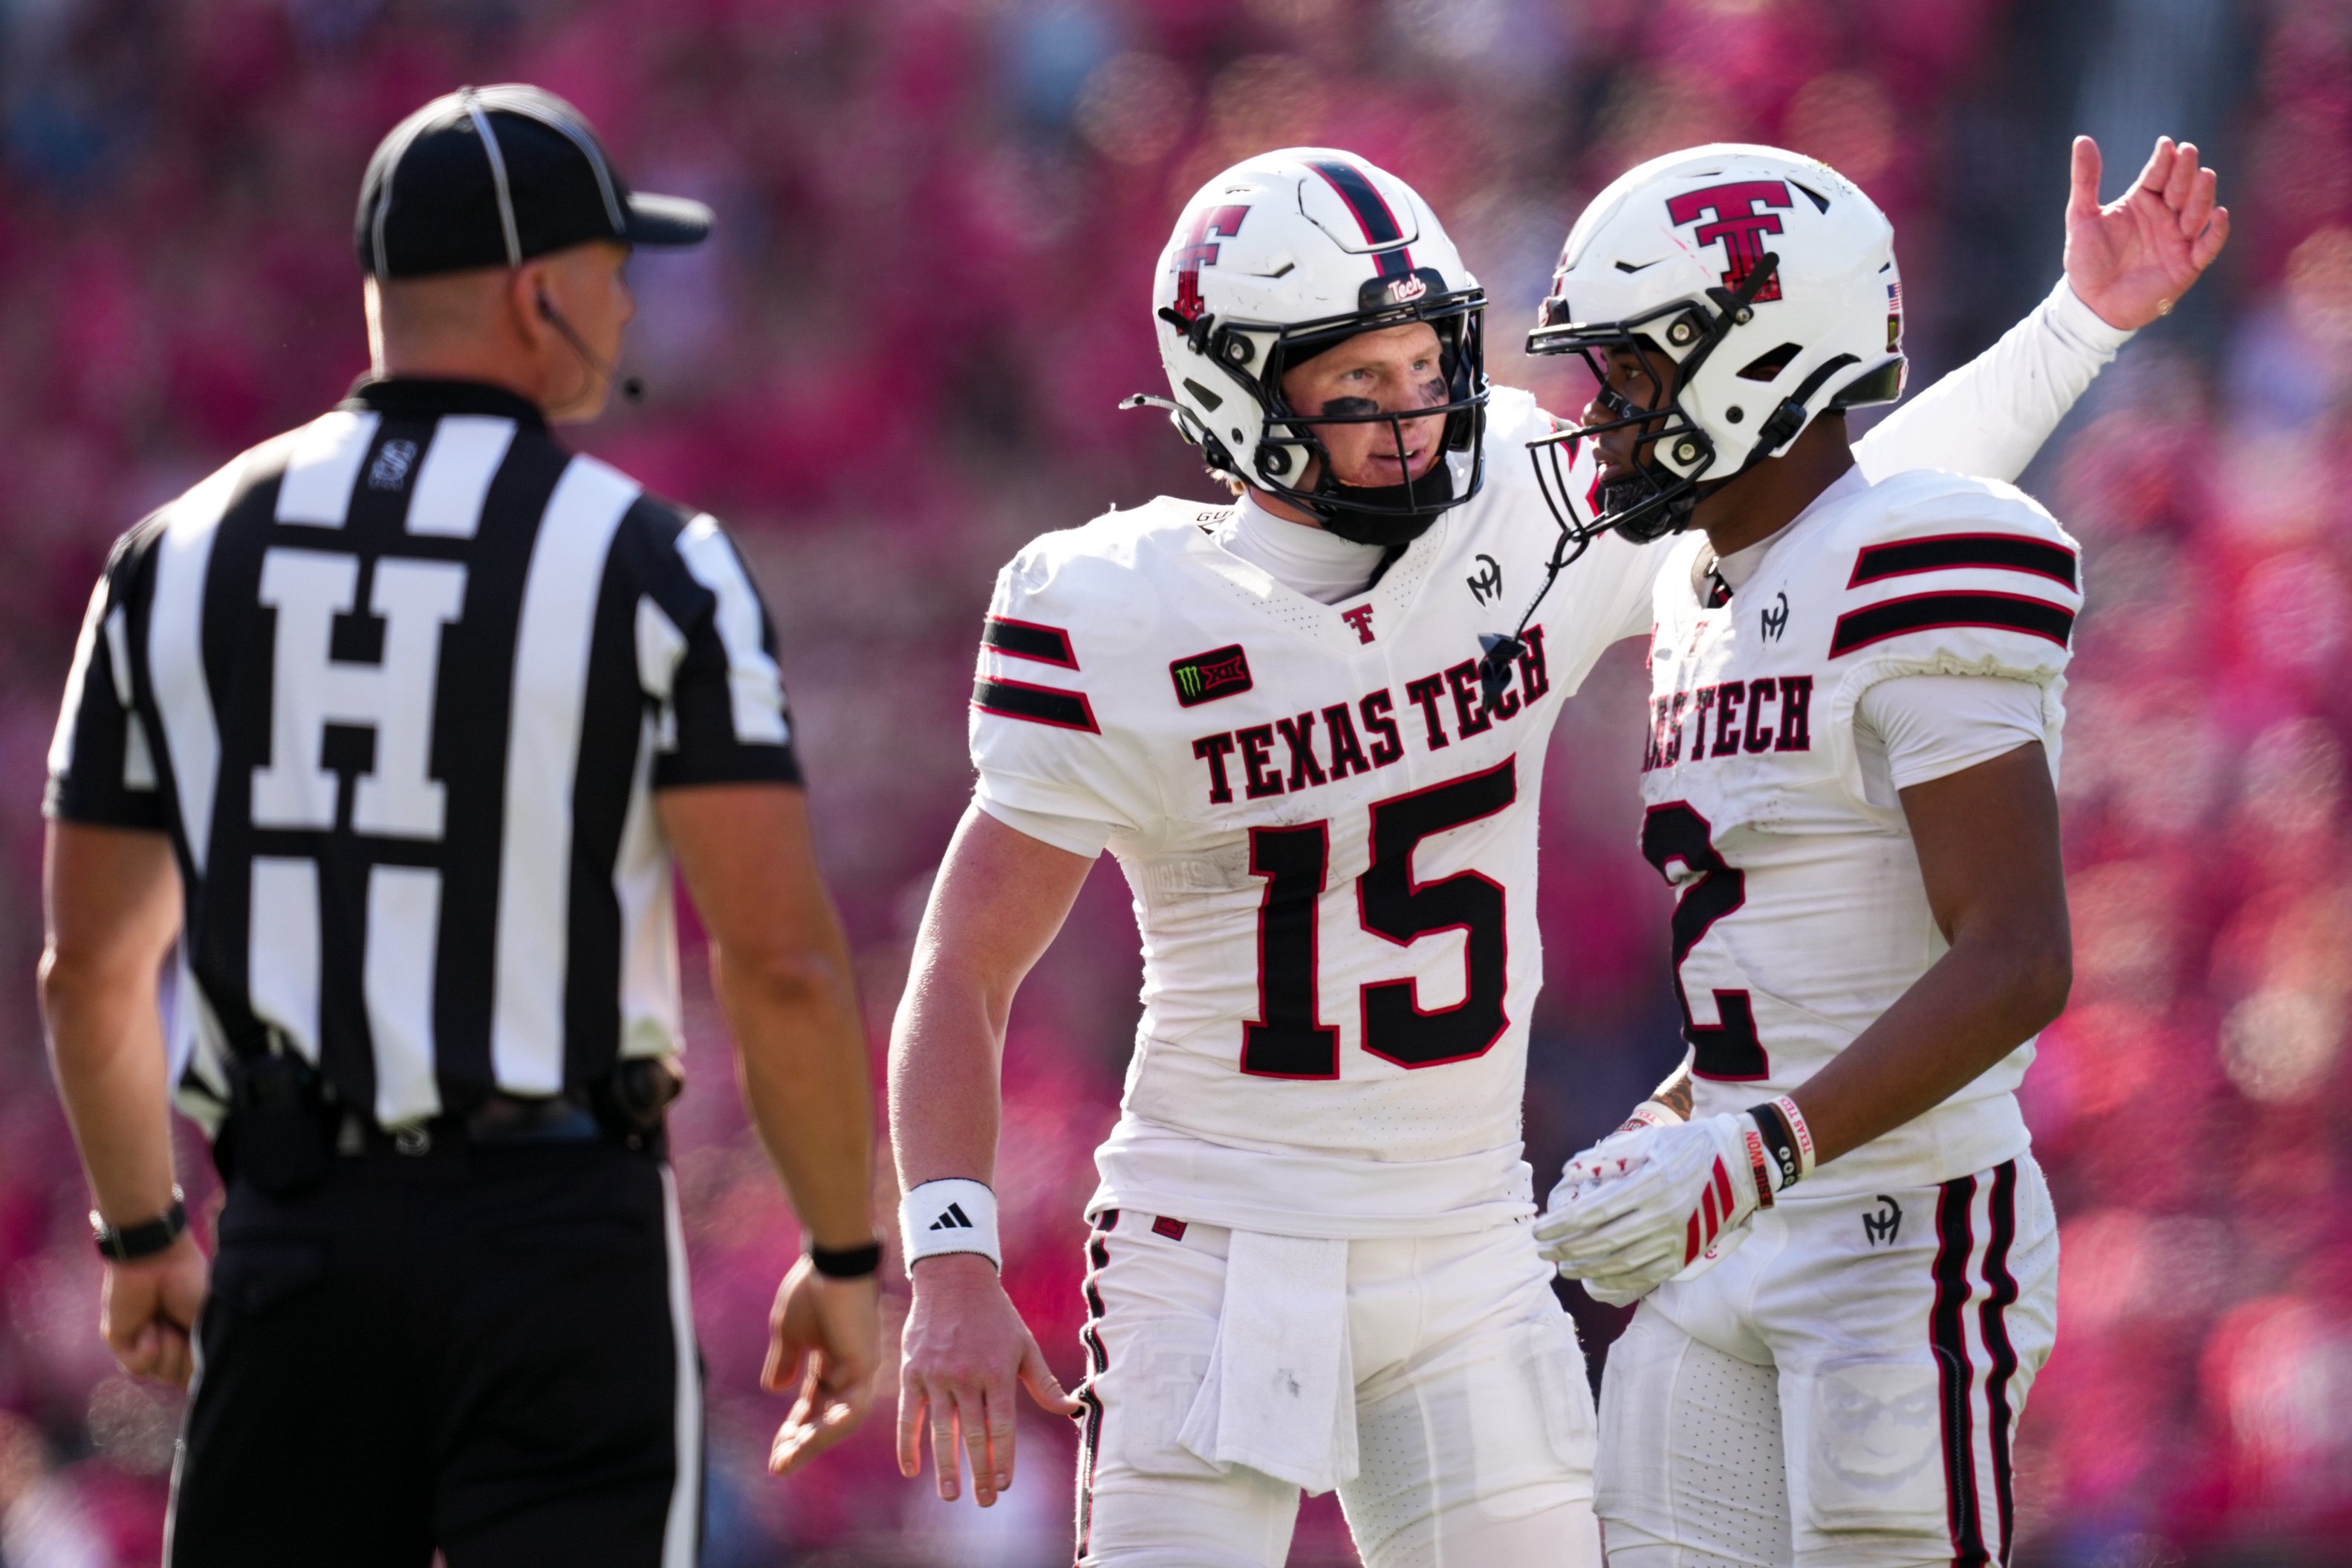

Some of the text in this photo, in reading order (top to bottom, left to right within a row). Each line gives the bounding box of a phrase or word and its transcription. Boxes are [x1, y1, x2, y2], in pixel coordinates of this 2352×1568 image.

[1387, 273, 1426, 303] Tech
[250, 547, 470, 842] H
[1192, 688, 1404, 804] TEXAS
[1690, 675, 1813, 762] TECH
[1240, 752, 1517, 1080] 15
[1643, 799, 1770, 1082] 2
[1793, 1119, 1813, 1156] TEXAS
